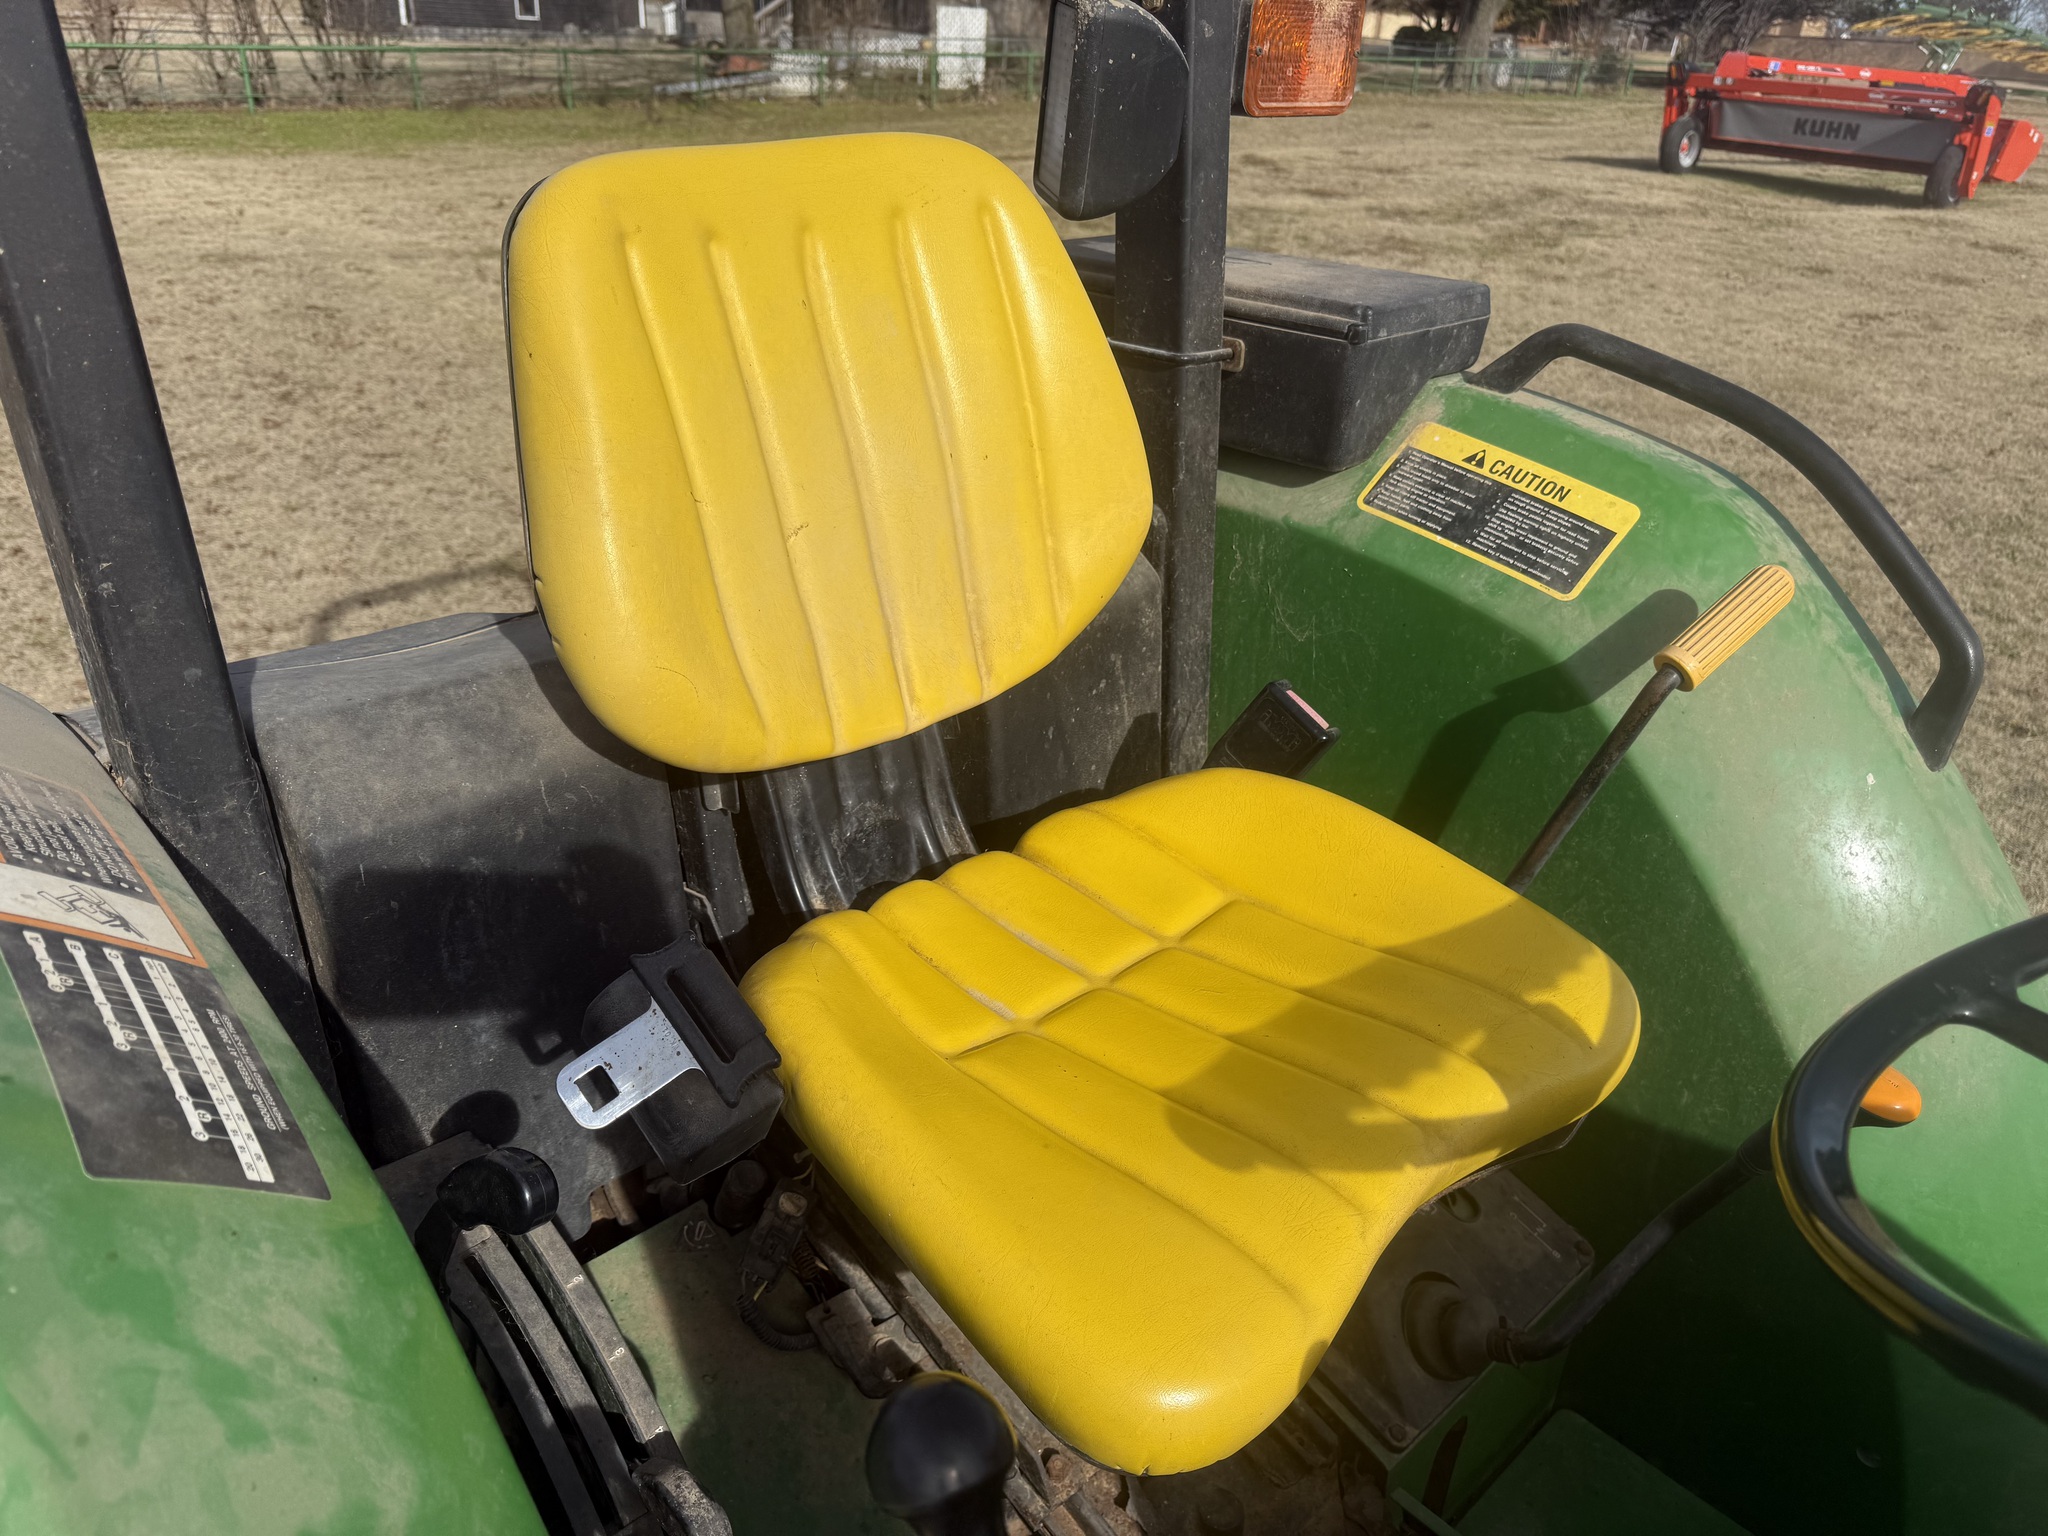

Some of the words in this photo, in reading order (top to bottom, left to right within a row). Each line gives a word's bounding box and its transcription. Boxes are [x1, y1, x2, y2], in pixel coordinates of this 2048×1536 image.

[1793, 117, 1861, 141] KUHN
[1489, 459, 1572, 502] CAUTION
[70, 943, 81, 951] B
[109, 952, 119, 960] C
[206, 1008, 221, 1025] RPM
[123, 1031, 136, 1039] R
[116, 1042, 128, 1050] 3
[226, 1045, 239, 1057] AT
[244, 1055, 258, 1073] WITH
[217, 1075, 226, 1084] 14
[234, 1060, 256, 1091] SPEEDS
[208, 1083, 218, 1091] 10
[253, 1072, 273, 1105] EQUIPPED
[215, 1097, 225, 1106] 12
[197, 1111, 210, 1120] R
[252, 1093, 276, 1131] GROUND
[223, 1113, 233, 1121] 14
[235, 1113, 245, 1123] 22
[271, 1103, 290, 1131] (WHEN
[195, 1130, 206, 1139] 3
[238, 1145, 247, 1154] 18
[254, 1153, 264, 1163] 30
[244, 1162, 255, 1172] 20
[615, 1348, 625, 1356] 3
